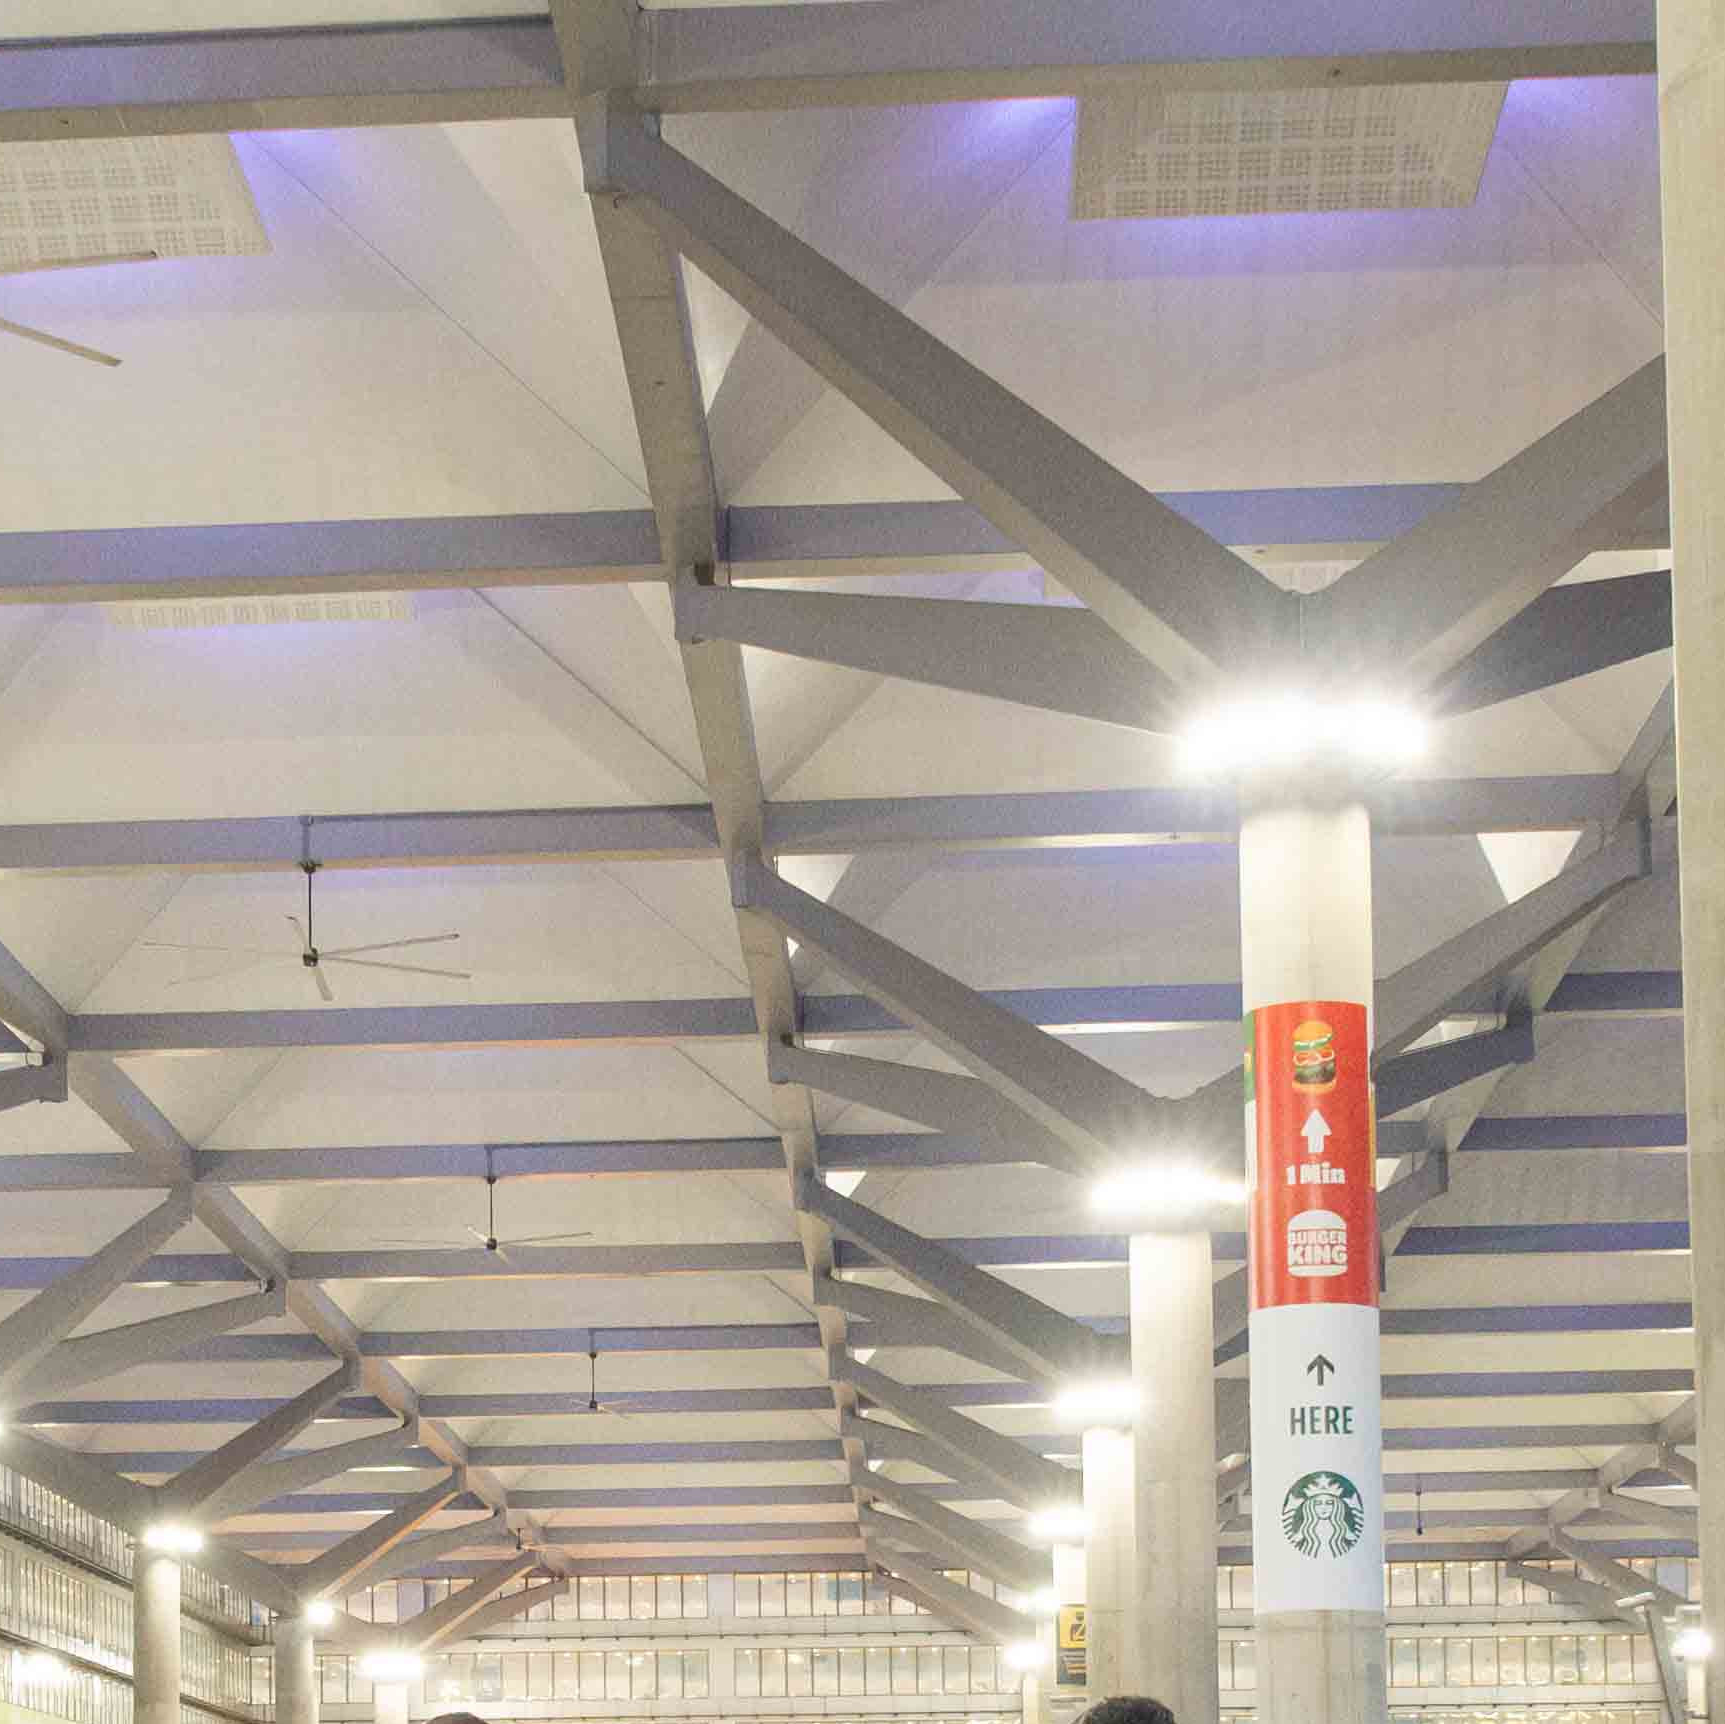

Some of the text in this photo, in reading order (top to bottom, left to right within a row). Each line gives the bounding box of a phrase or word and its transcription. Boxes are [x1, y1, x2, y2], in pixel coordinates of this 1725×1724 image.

[1300, 1161, 1346, 1185] Min
[1288, 1231, 1347, 1246] BURGER
[1288, 1245, 1348, 1266] KING
[1290, 1407, 1354, 1435] HERE
